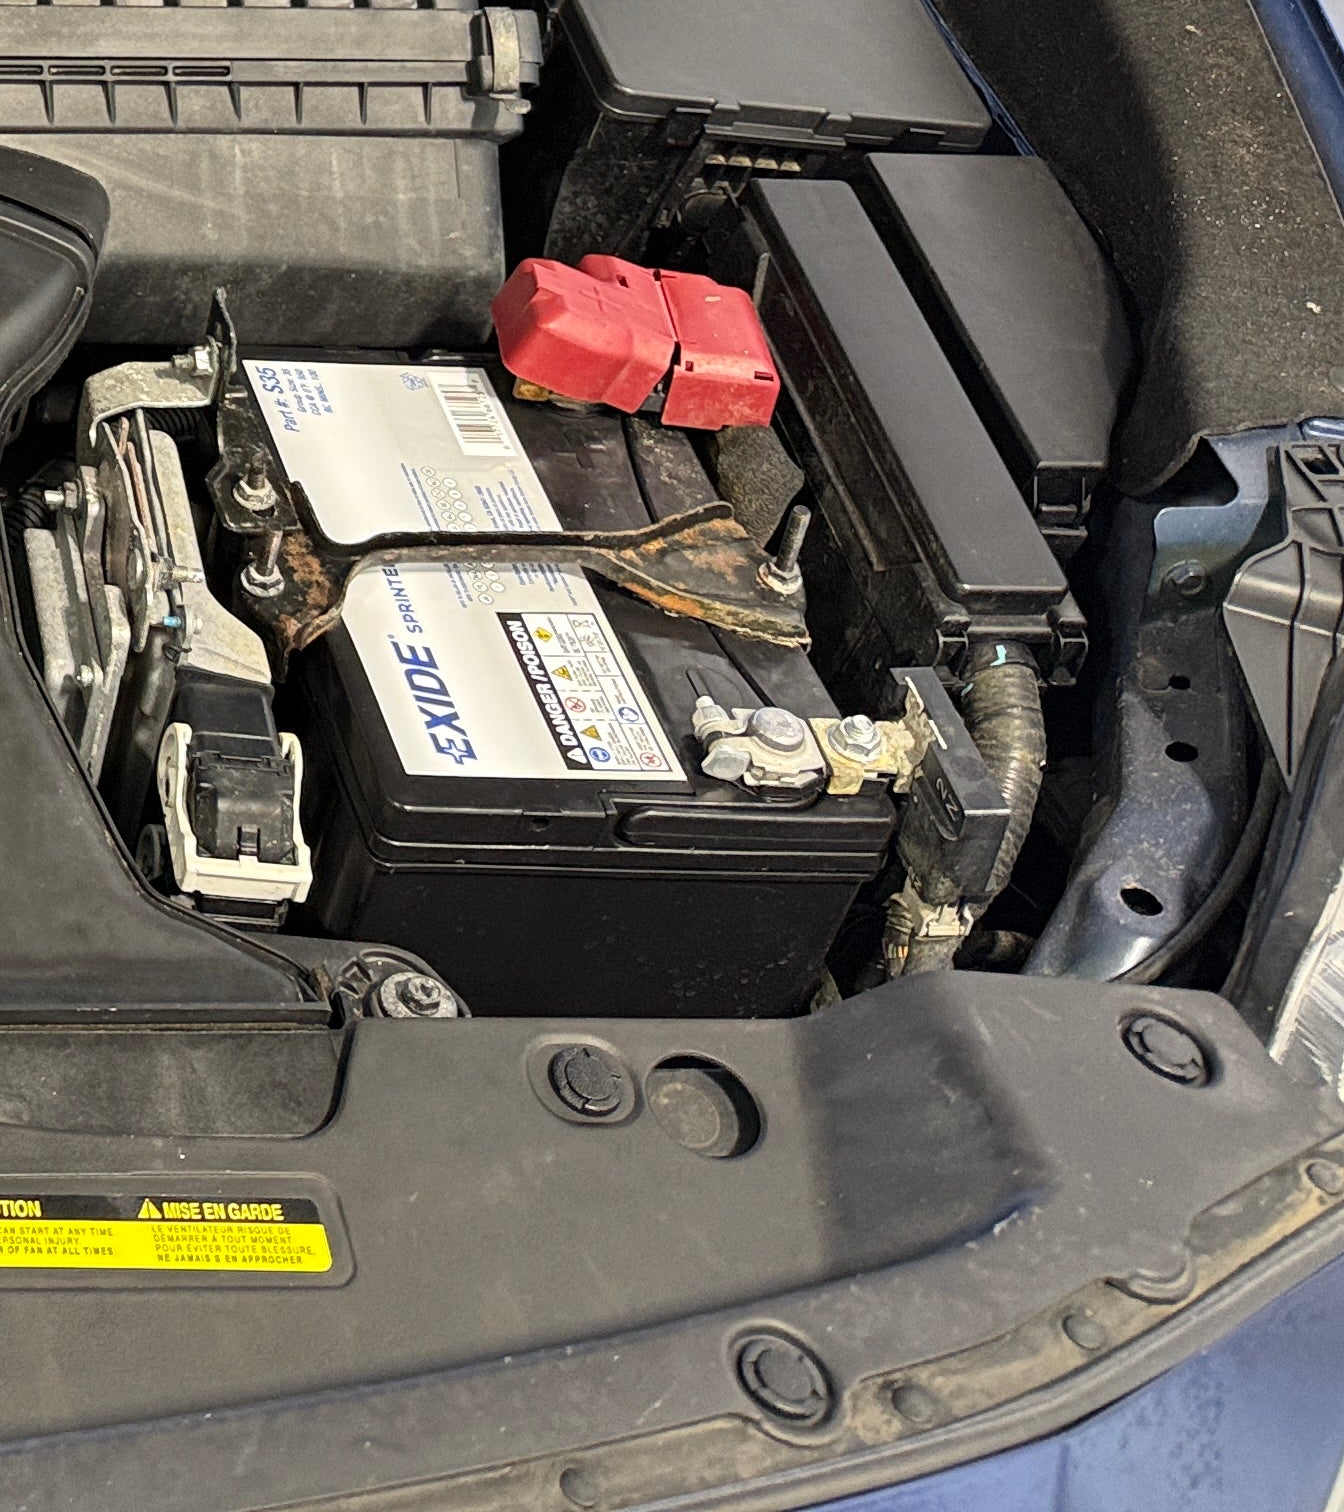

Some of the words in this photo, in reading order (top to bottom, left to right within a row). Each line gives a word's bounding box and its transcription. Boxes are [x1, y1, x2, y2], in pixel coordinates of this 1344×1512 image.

[255, 365, 284, 394] S35
[382, 563, 423, 634] SPRINTE
[389, 640, 479, 766] EXIDE
[162, 1201, 202, 1219] MISE
[203, 1202, 227, 1220] EN
[227, 1202, 285, 1221] GARDE
[19, 1226, 50, 1236] START
[53, 1226, 64, 1236] AT
[68, 1227, 87, 1236] ANY
[151, 1225, 164, 1234] LE
[167, 1225, 234, 1234] VENTILATEUR
[237, 1226, 273, 1235] RISQUE
[277, 1226, 291, 1236] DE
[221, 1235, 248, 1244] TOUT
[7, 1245, 20, 1255] OF
[24, 1246, 44, 1255] FAN
[46, 1246, 58, 1255] AT
[62, 1246, 80, 1256] ALL
[155, 1243, 183, 1253] POUR
[224, 1245, 258, 1254] TOUTE
[157, 1254, 170, 1262] NE
[174, 1254, 211, 1263] JAMAIS
